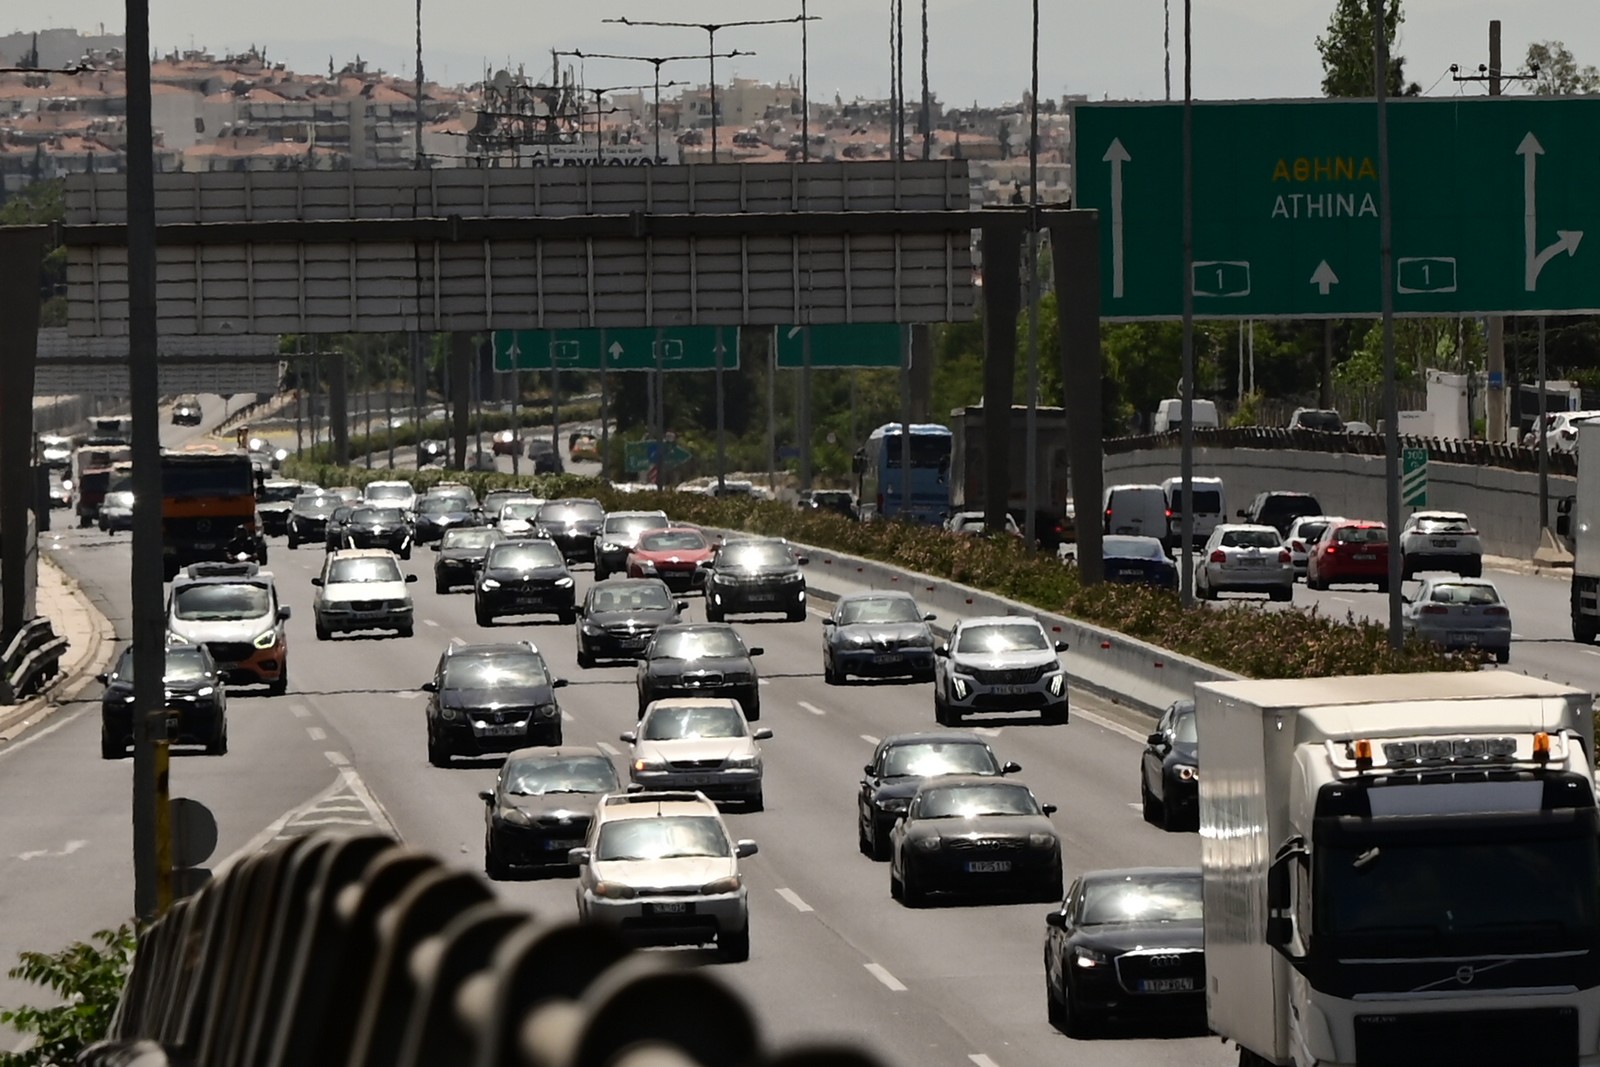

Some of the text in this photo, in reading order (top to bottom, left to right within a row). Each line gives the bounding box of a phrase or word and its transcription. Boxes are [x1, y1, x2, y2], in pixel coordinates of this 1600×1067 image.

[1272, 156, 1378, 182] ΑΘΗΝΑ
[1271, 192, 1379, 218] ATHINA
[1216, 268, 1224, 289] 1
[1422, 264, 1430, 285] 1
